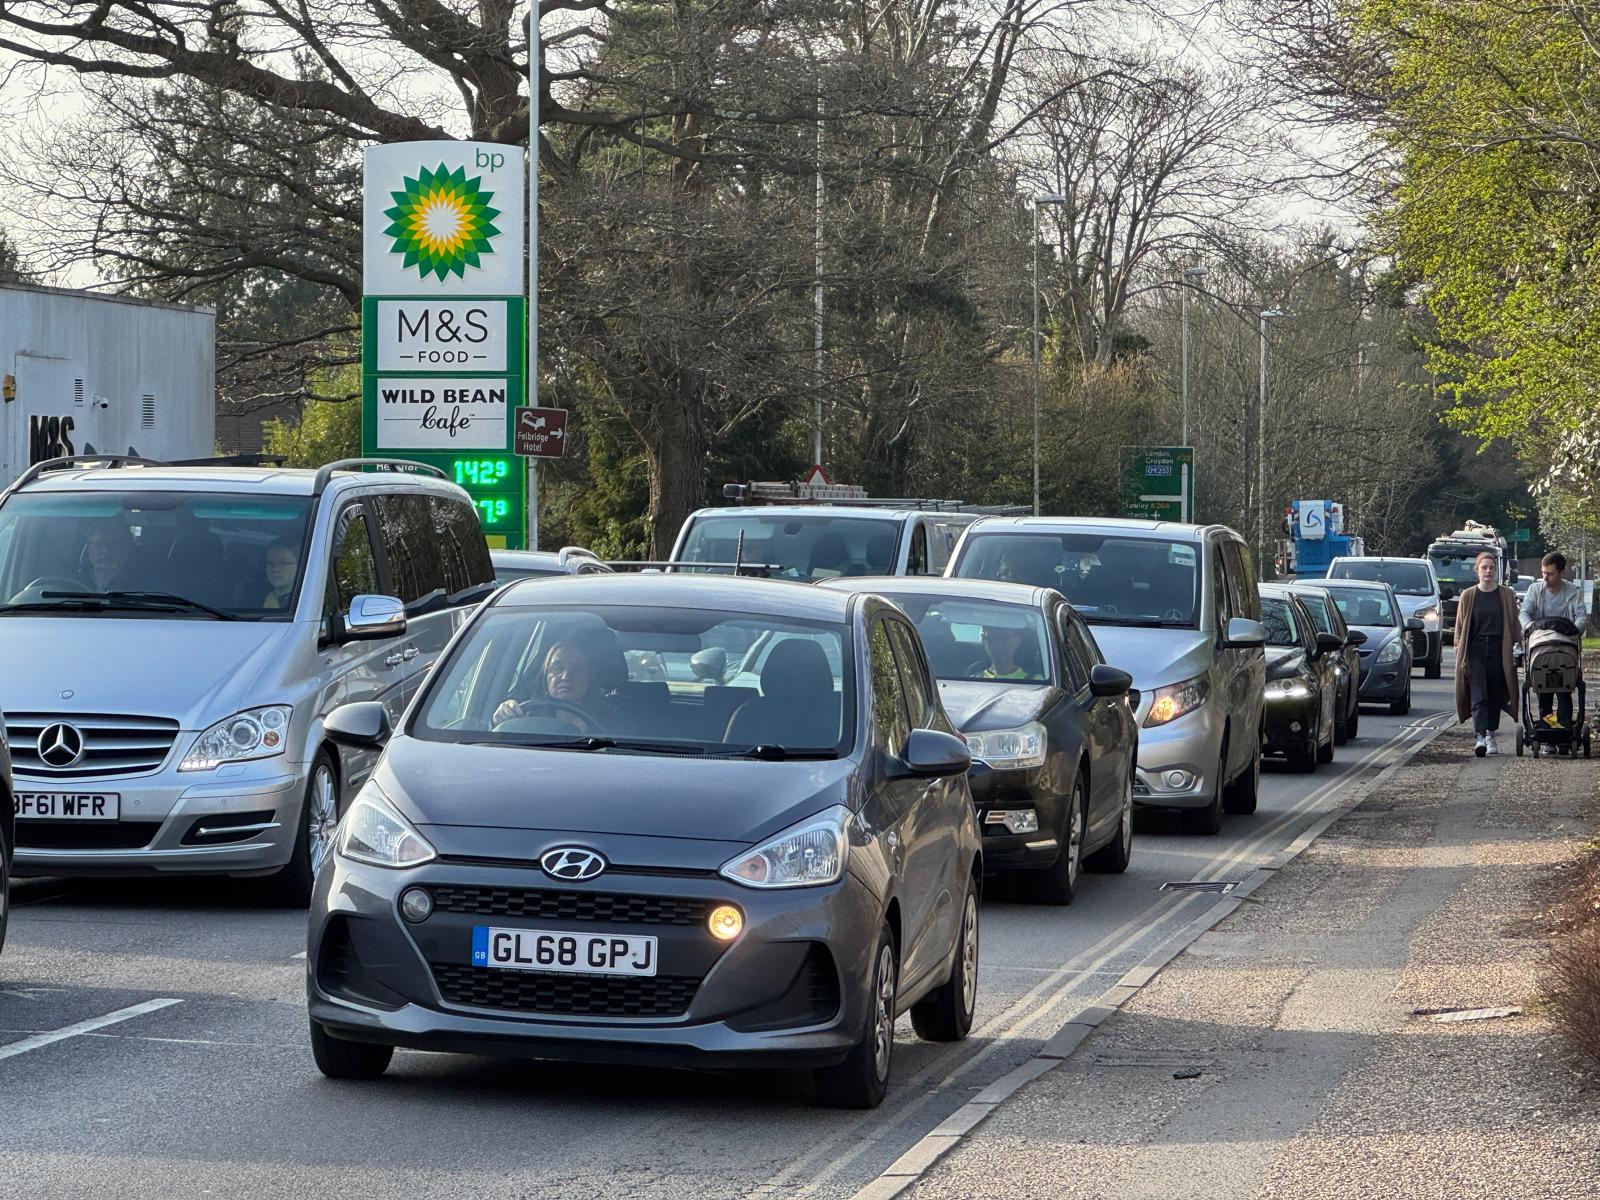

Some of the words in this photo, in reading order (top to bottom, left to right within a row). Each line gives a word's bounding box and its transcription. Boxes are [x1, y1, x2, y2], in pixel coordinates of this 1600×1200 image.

[476, 148, 504, 172] bp
[398, 309, 488, 343] M&S
[418, 351, 469, 363] FOOD
[382, 389, 435, 404] WILD
[443, 389, 505, 403] BEAN
[30, 415, 75, 469] M&S
[517, 431, 549, 443] Felbridge
[523, 442, 542, 452] Hotel
[1123, 502, 1149, 510] rawley
[63, 795, 105, 816] WFR
[474, 951, 486, 959] GB
[493, 933, 577, 965] GL68
[587, 938, 651, 969] GPJ
